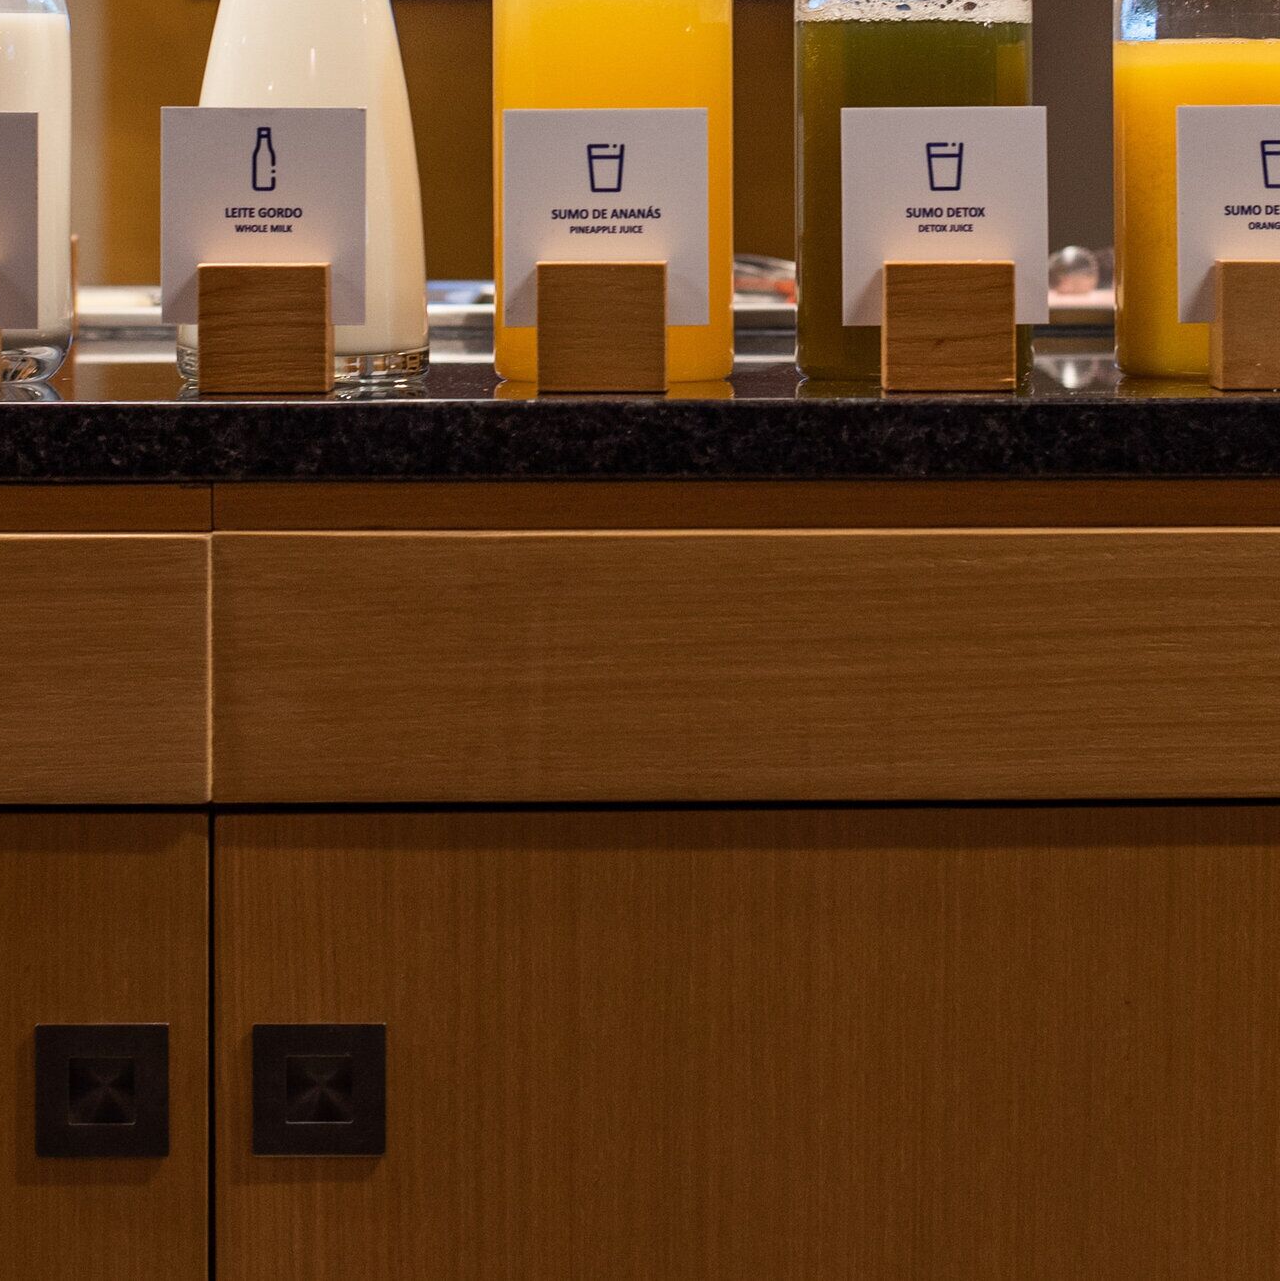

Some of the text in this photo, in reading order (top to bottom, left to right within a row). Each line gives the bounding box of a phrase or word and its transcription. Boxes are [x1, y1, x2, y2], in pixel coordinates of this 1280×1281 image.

[225, 207, 303, 218] LEITE GORDO
[551, 205, 661, 219] SUMO DE ANANÁS
[905, 207, 986, 218] SUMO DETOX
[1224, 205, 1262, 216] SUMO
[1265, 205, 1280, 215] DE
[235, 224, 292, 233] WHOLE MILK
[569, 225, 643, 234] PINEAPPLE JUICE
[918, 224, 974, 233] DETOX JUICE
